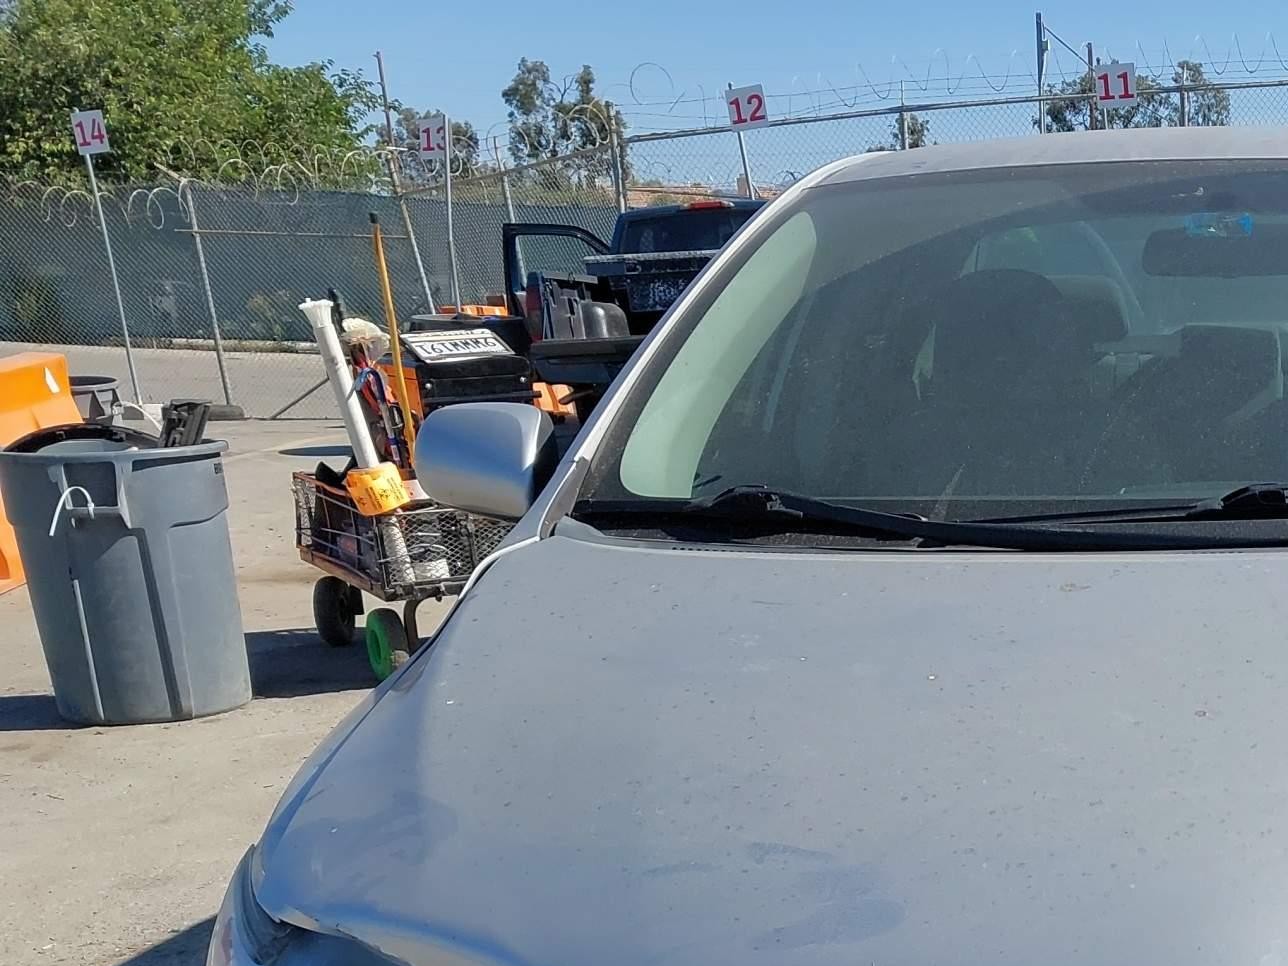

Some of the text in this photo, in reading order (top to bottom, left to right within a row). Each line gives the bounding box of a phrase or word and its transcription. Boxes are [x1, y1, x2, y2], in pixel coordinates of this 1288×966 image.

[1098, 72, 1133, 100] 11
[730, 94, 766, 125] 12
[75, 118, 105, 147] 14
